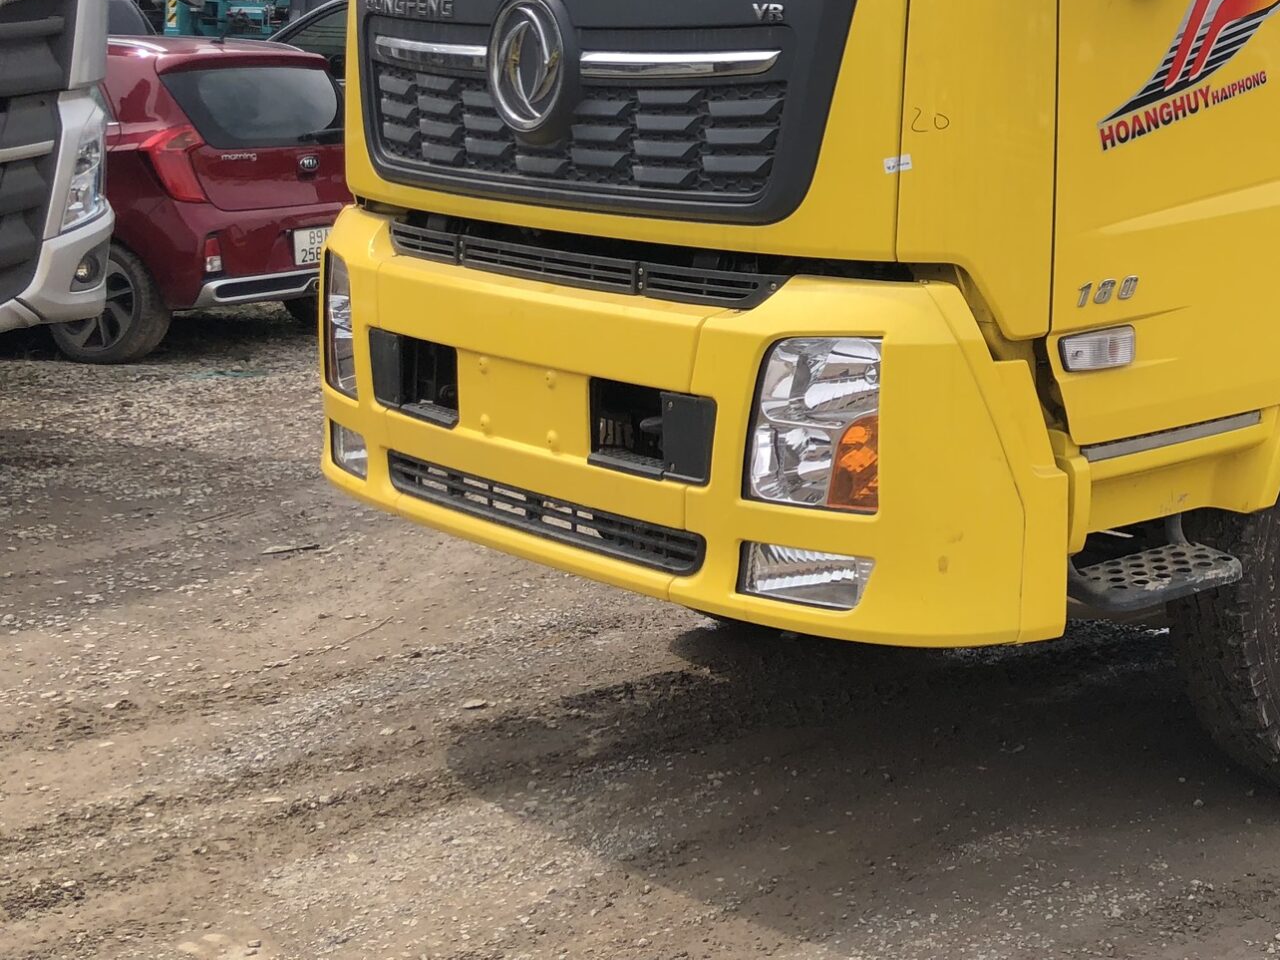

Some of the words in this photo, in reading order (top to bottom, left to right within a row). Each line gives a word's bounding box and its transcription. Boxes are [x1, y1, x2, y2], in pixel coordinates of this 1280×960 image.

[752, 3, 784, 21] VR
[1099, 84, 1211, 151] HOANGHUY
[1210, 70, 1267, 106] HAIPHONG
[1077, 274, 1139, 308] 180
